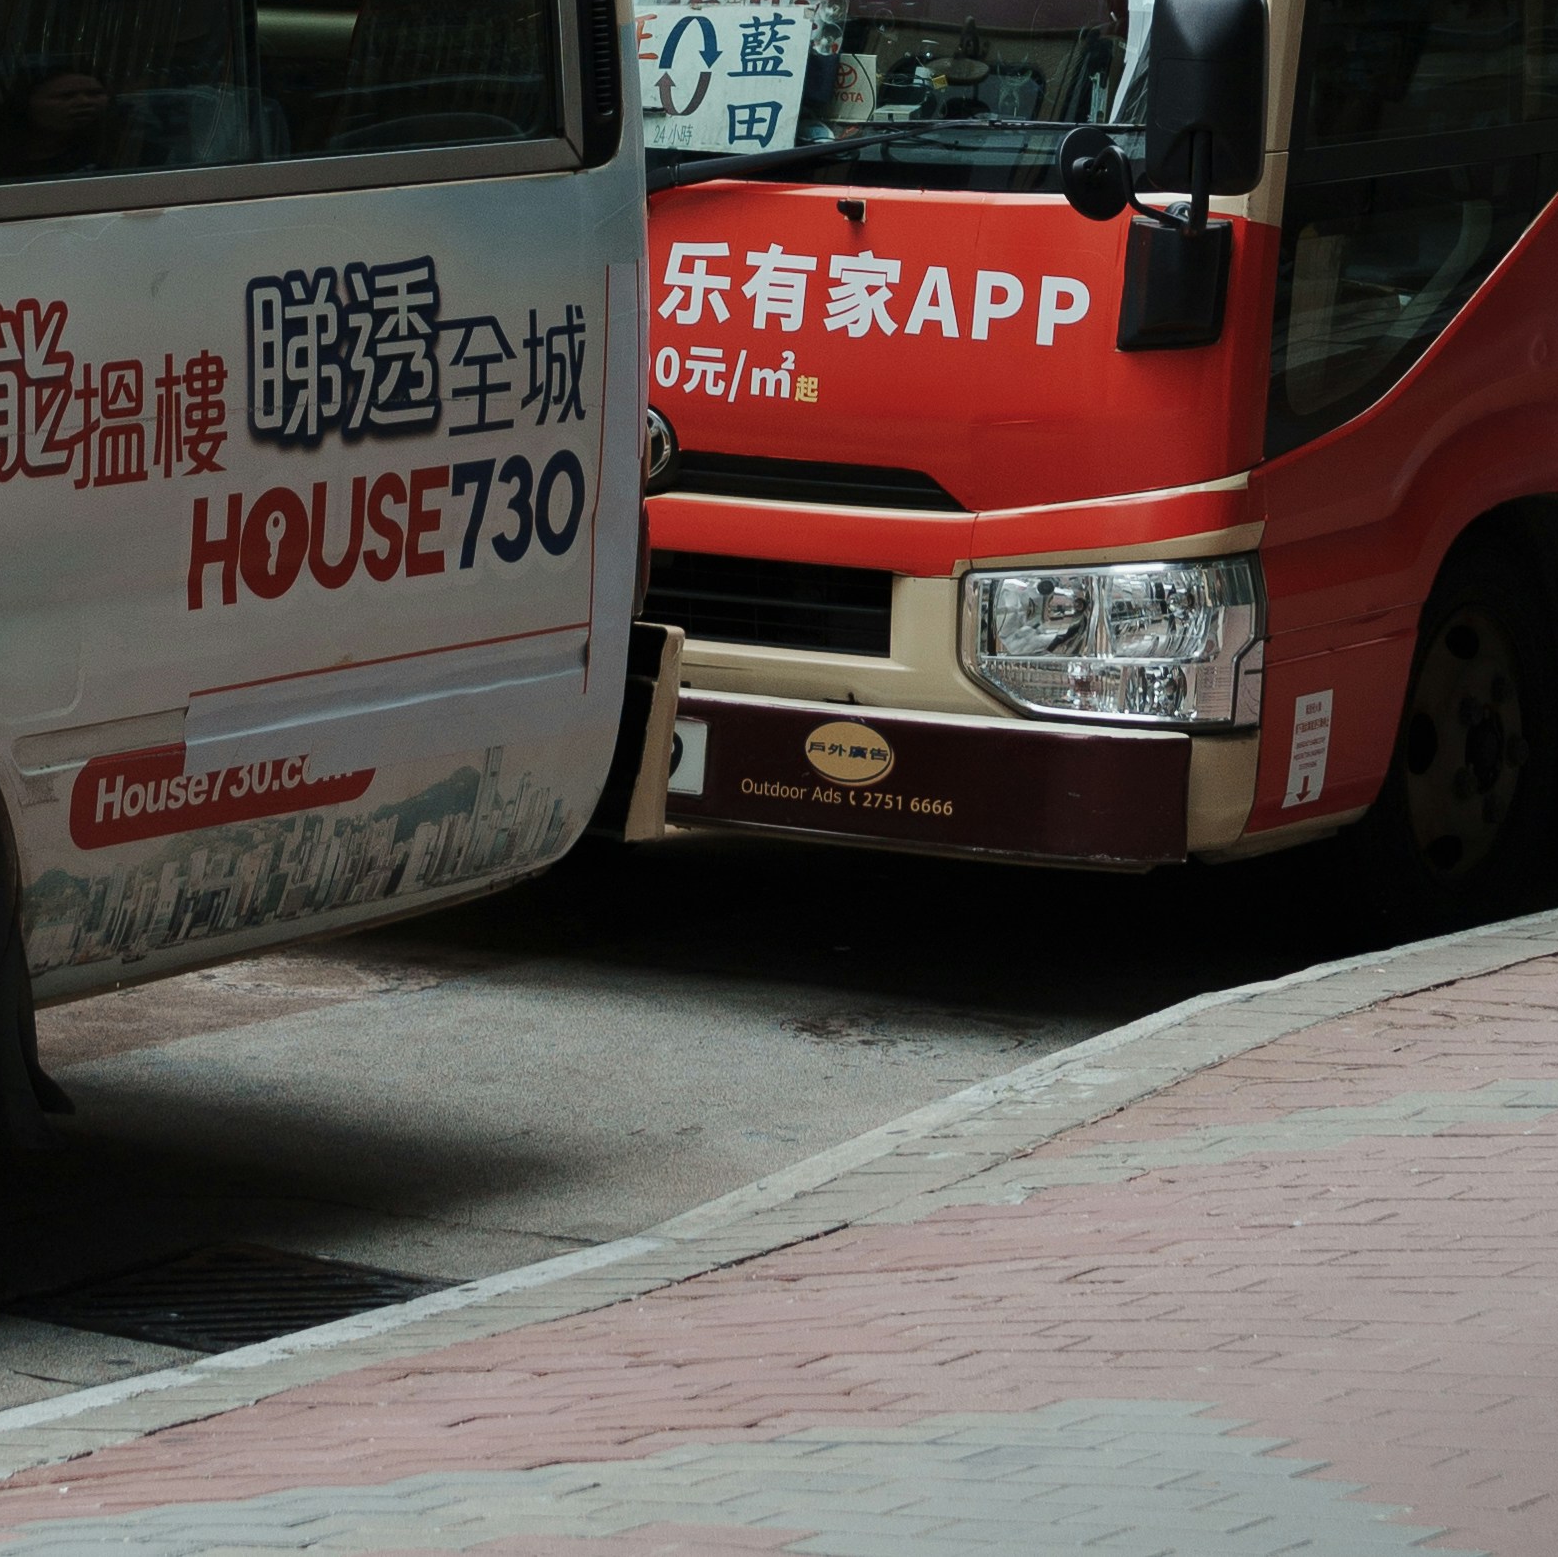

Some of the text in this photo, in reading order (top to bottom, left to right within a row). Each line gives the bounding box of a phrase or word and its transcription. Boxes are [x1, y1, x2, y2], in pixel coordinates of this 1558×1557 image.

[727, 12, 797, 148] 藍田
[833, 91, 864, 104] YOTA
[657, 241, 1092, 347] 乐有家APP
[187, 449, 588, 613] HOUSE730
[806, 739, 891, 764] 戶外廣告
[94, 758, 353, 824] House730.co
[740, 777, 954, 818] Outdoor Ads 2751 6666
